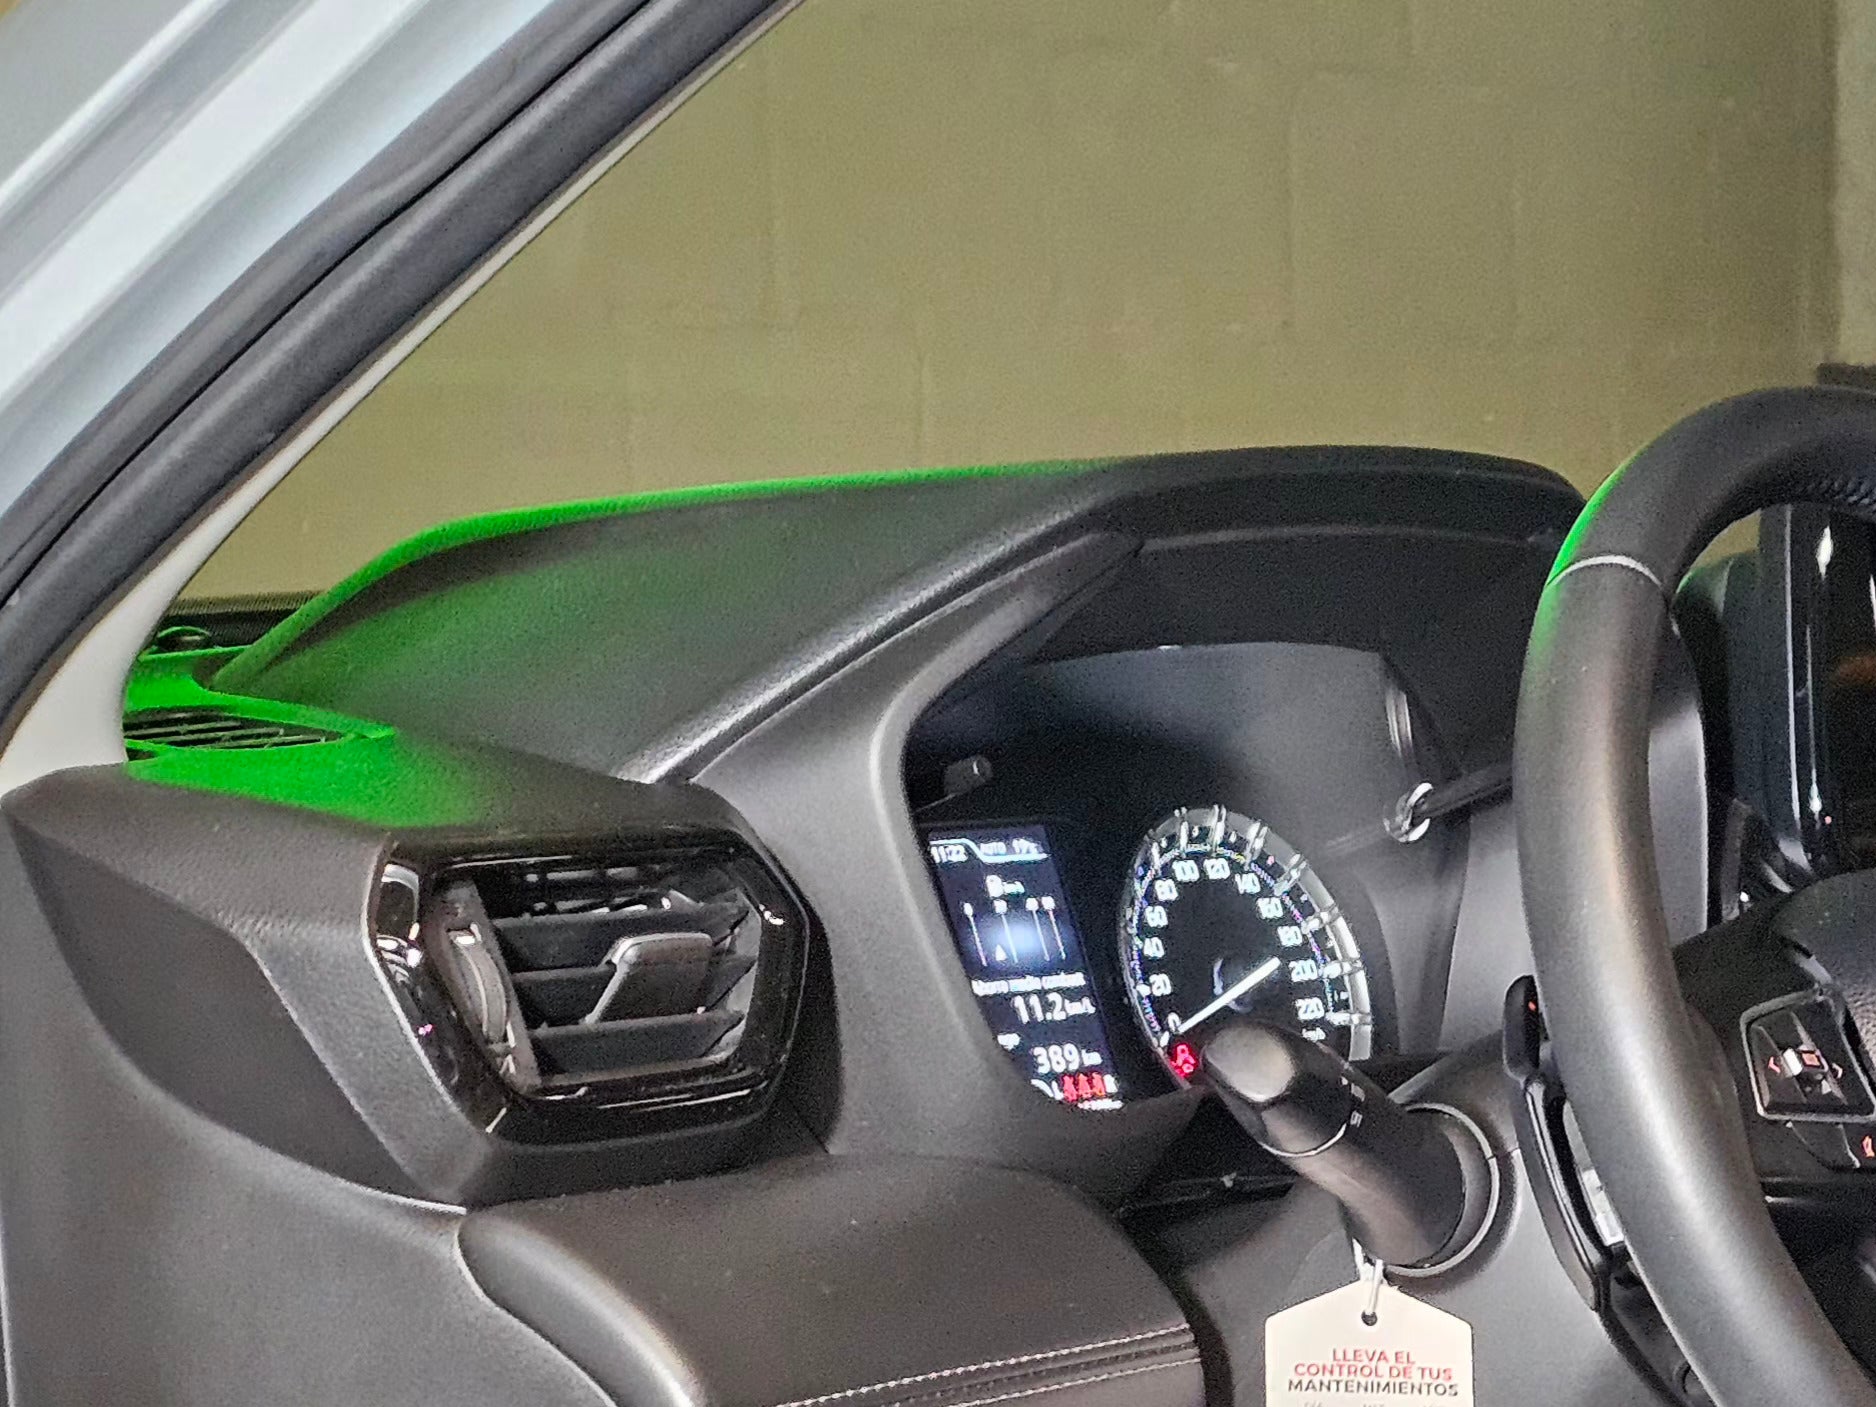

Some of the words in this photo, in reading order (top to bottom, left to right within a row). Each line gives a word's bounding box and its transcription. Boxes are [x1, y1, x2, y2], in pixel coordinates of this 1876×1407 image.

[1172, 859, 1200, 882] 100
[1203, 857, 1231, 880] 120
[1154, 878, 1179, 901] 80
[1234, 872, 1262, 894] 140
[1145, 905, 1168, 928] 60
[1256, 896, 1284, 920] 160
[1143, 936, 1165, 958] 40
[1277, 924, 1302, 947] 180
[1289, 958, 1318, 983] 200
[1149, 972, 1172, 997] 20
[1013, 992, 1066, 1024] 11.2
[1295, 996, 1325, 1020] 220
[1033, 1043, 1080, 1074] 389
[1332, 1347, 1390, 1364] LLEVA
[1394, 1350, 1416, 1365] EL
[1294, 1362, 1383, 1379] CONTROL
[1388, 1363, 1413, 1380] DE
[1417, 1366, 1454, 1382] TUS
[1287, 1378, 1459, 1397] MANTENIMIENTOS
